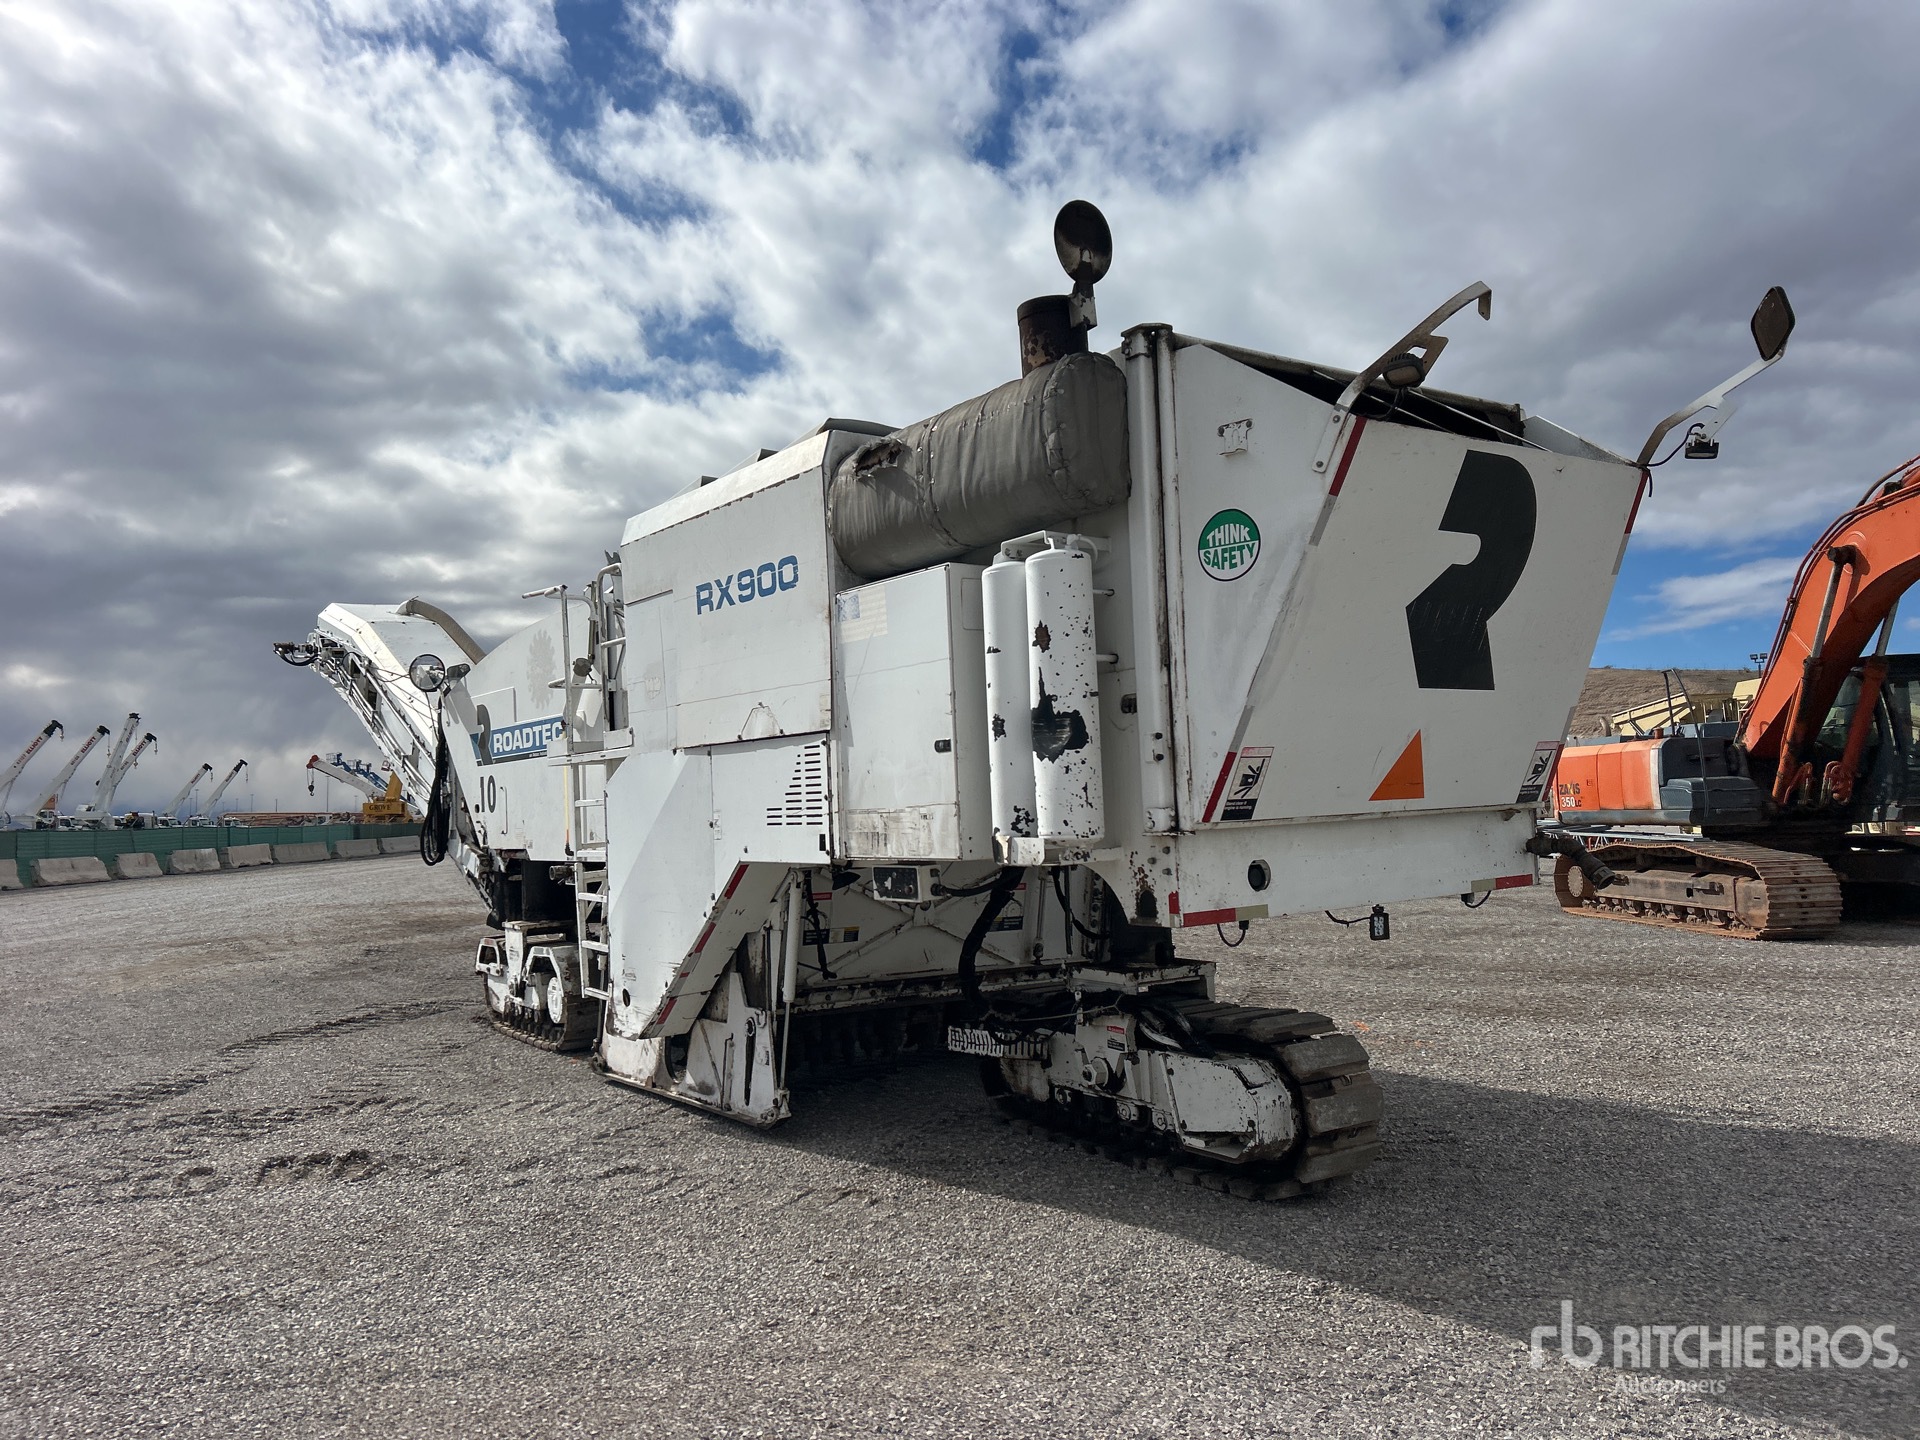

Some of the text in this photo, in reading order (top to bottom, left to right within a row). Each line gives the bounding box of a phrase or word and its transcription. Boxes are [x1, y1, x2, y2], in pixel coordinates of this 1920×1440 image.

[1206, 523, 1251, 547] THINK
[1203, 542, 1255, 570] SAFETY
[695, 555, 799, 615] RX900
[26, 736, 43, 754] ELLIOTT
[81, 736, 96, 754] ELLIOTT
[132, 740, 147, 756] ELLIOTT
[492, 721, 562, 753] ROADTEC
[480, 775, 496, 813] 10
[1559, 782, 1580, 795] ZAXIS
